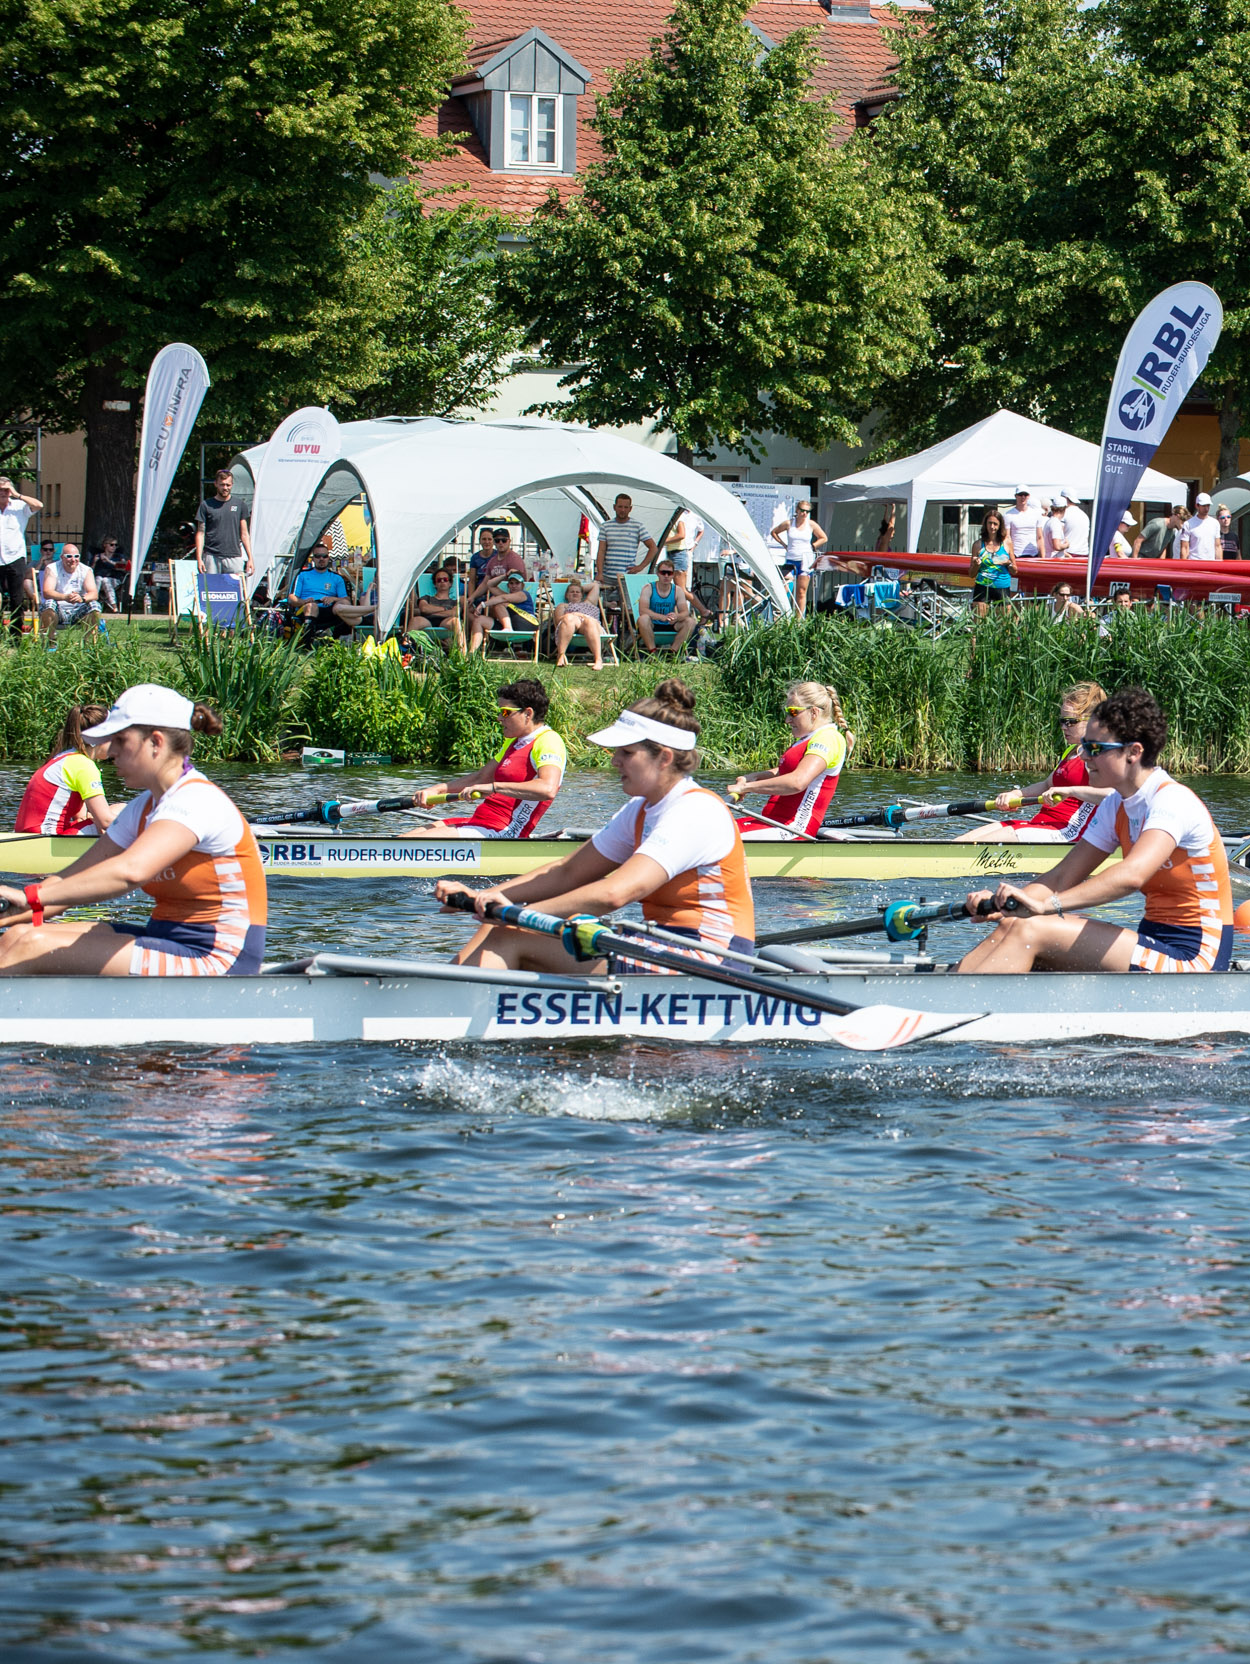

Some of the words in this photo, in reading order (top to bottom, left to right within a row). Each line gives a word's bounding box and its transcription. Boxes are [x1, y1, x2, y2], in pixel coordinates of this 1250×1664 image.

[1136, 305, 1204, 389] RBL
[1161, 312, 1211, 394] RUDER-BUNDESLIGA
[1107, 442, 1136, 455] STARK.
[1106, 453, 1144, 467] SCHNELL.
[1104, 464, 1124, 475] GUT.
[273, 843, 322, 861] RBL
[327, 848, 476, 862] RUDER-BUNDESLIGA
[496, 992, 822, 1027] ESSEN-KETTWIG
